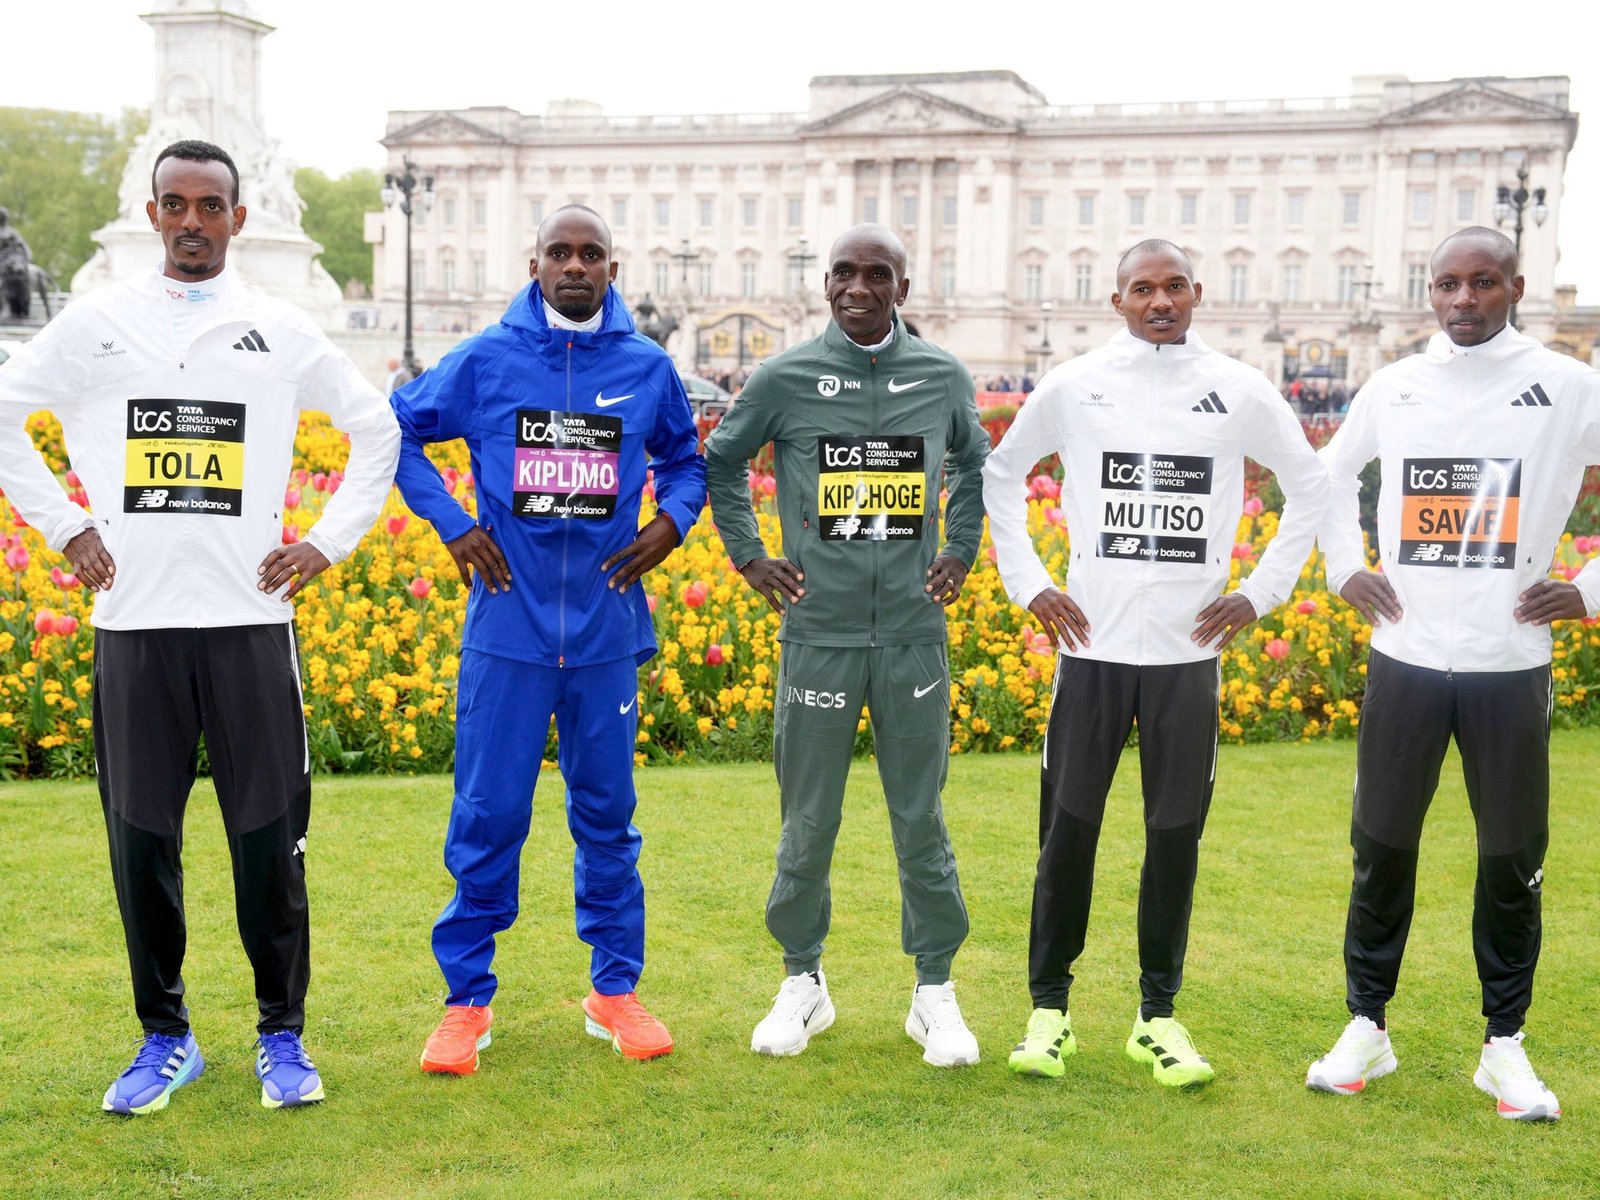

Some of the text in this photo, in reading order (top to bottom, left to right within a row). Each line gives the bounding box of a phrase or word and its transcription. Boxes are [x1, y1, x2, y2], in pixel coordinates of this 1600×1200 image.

[844, 380, 861, 389] NN
[176, 406, 204, 414] TATA
[134, 406, 172, 432] tcs
[176, 415, 238, 427] CONSULTANCY
[562, 418, 586, 427] TATA
[176, 424, 216, 434] SERVICES
[522, 416, 558, 442] tcs
[562, 427, 616, 438] CONSULTANCY
[562, 436, 596, 445] SERVICES
[825, 442, 862, 467] tcs
[866, 450, 918, 458] CONSULTANCY
[144, 451, 224, 481] TOLA
[866, 458, 900, 466] SERVICES
[1152, 460, 1175, 468] TATA
[1108, 458, 1146, 484] tcs
[1452, 464, 1478, 472] TATA
[518, 460, 615, 490] KIPLIMO
[1150, 470, 1206, 480] CONSULTANCY
[1410, 464, 1448, 490] tcs
[1452, 473, 1512, 482] CONSULY
[1150, 478, 1186, 487] SERVICES
[1451, 482, 1484, 490] SERVIC
[824, 484, 922, 510] KIPCHOGE
[168, 500, 190, 508] new
[191, 499, 232, 510] balance
[554, 505, 572, 514] new
[574, 505, 607, 515] balance
[1104, 502, 1204, 532] MUTISO
[1418, 508, 1499, 536] SAWE
[1140, 548, 1159, 556] new
[1160, 548, 1196, 558] balance
[1464, 554, 1506, 564] balance
[788, 686, 846, 708] INEOS
